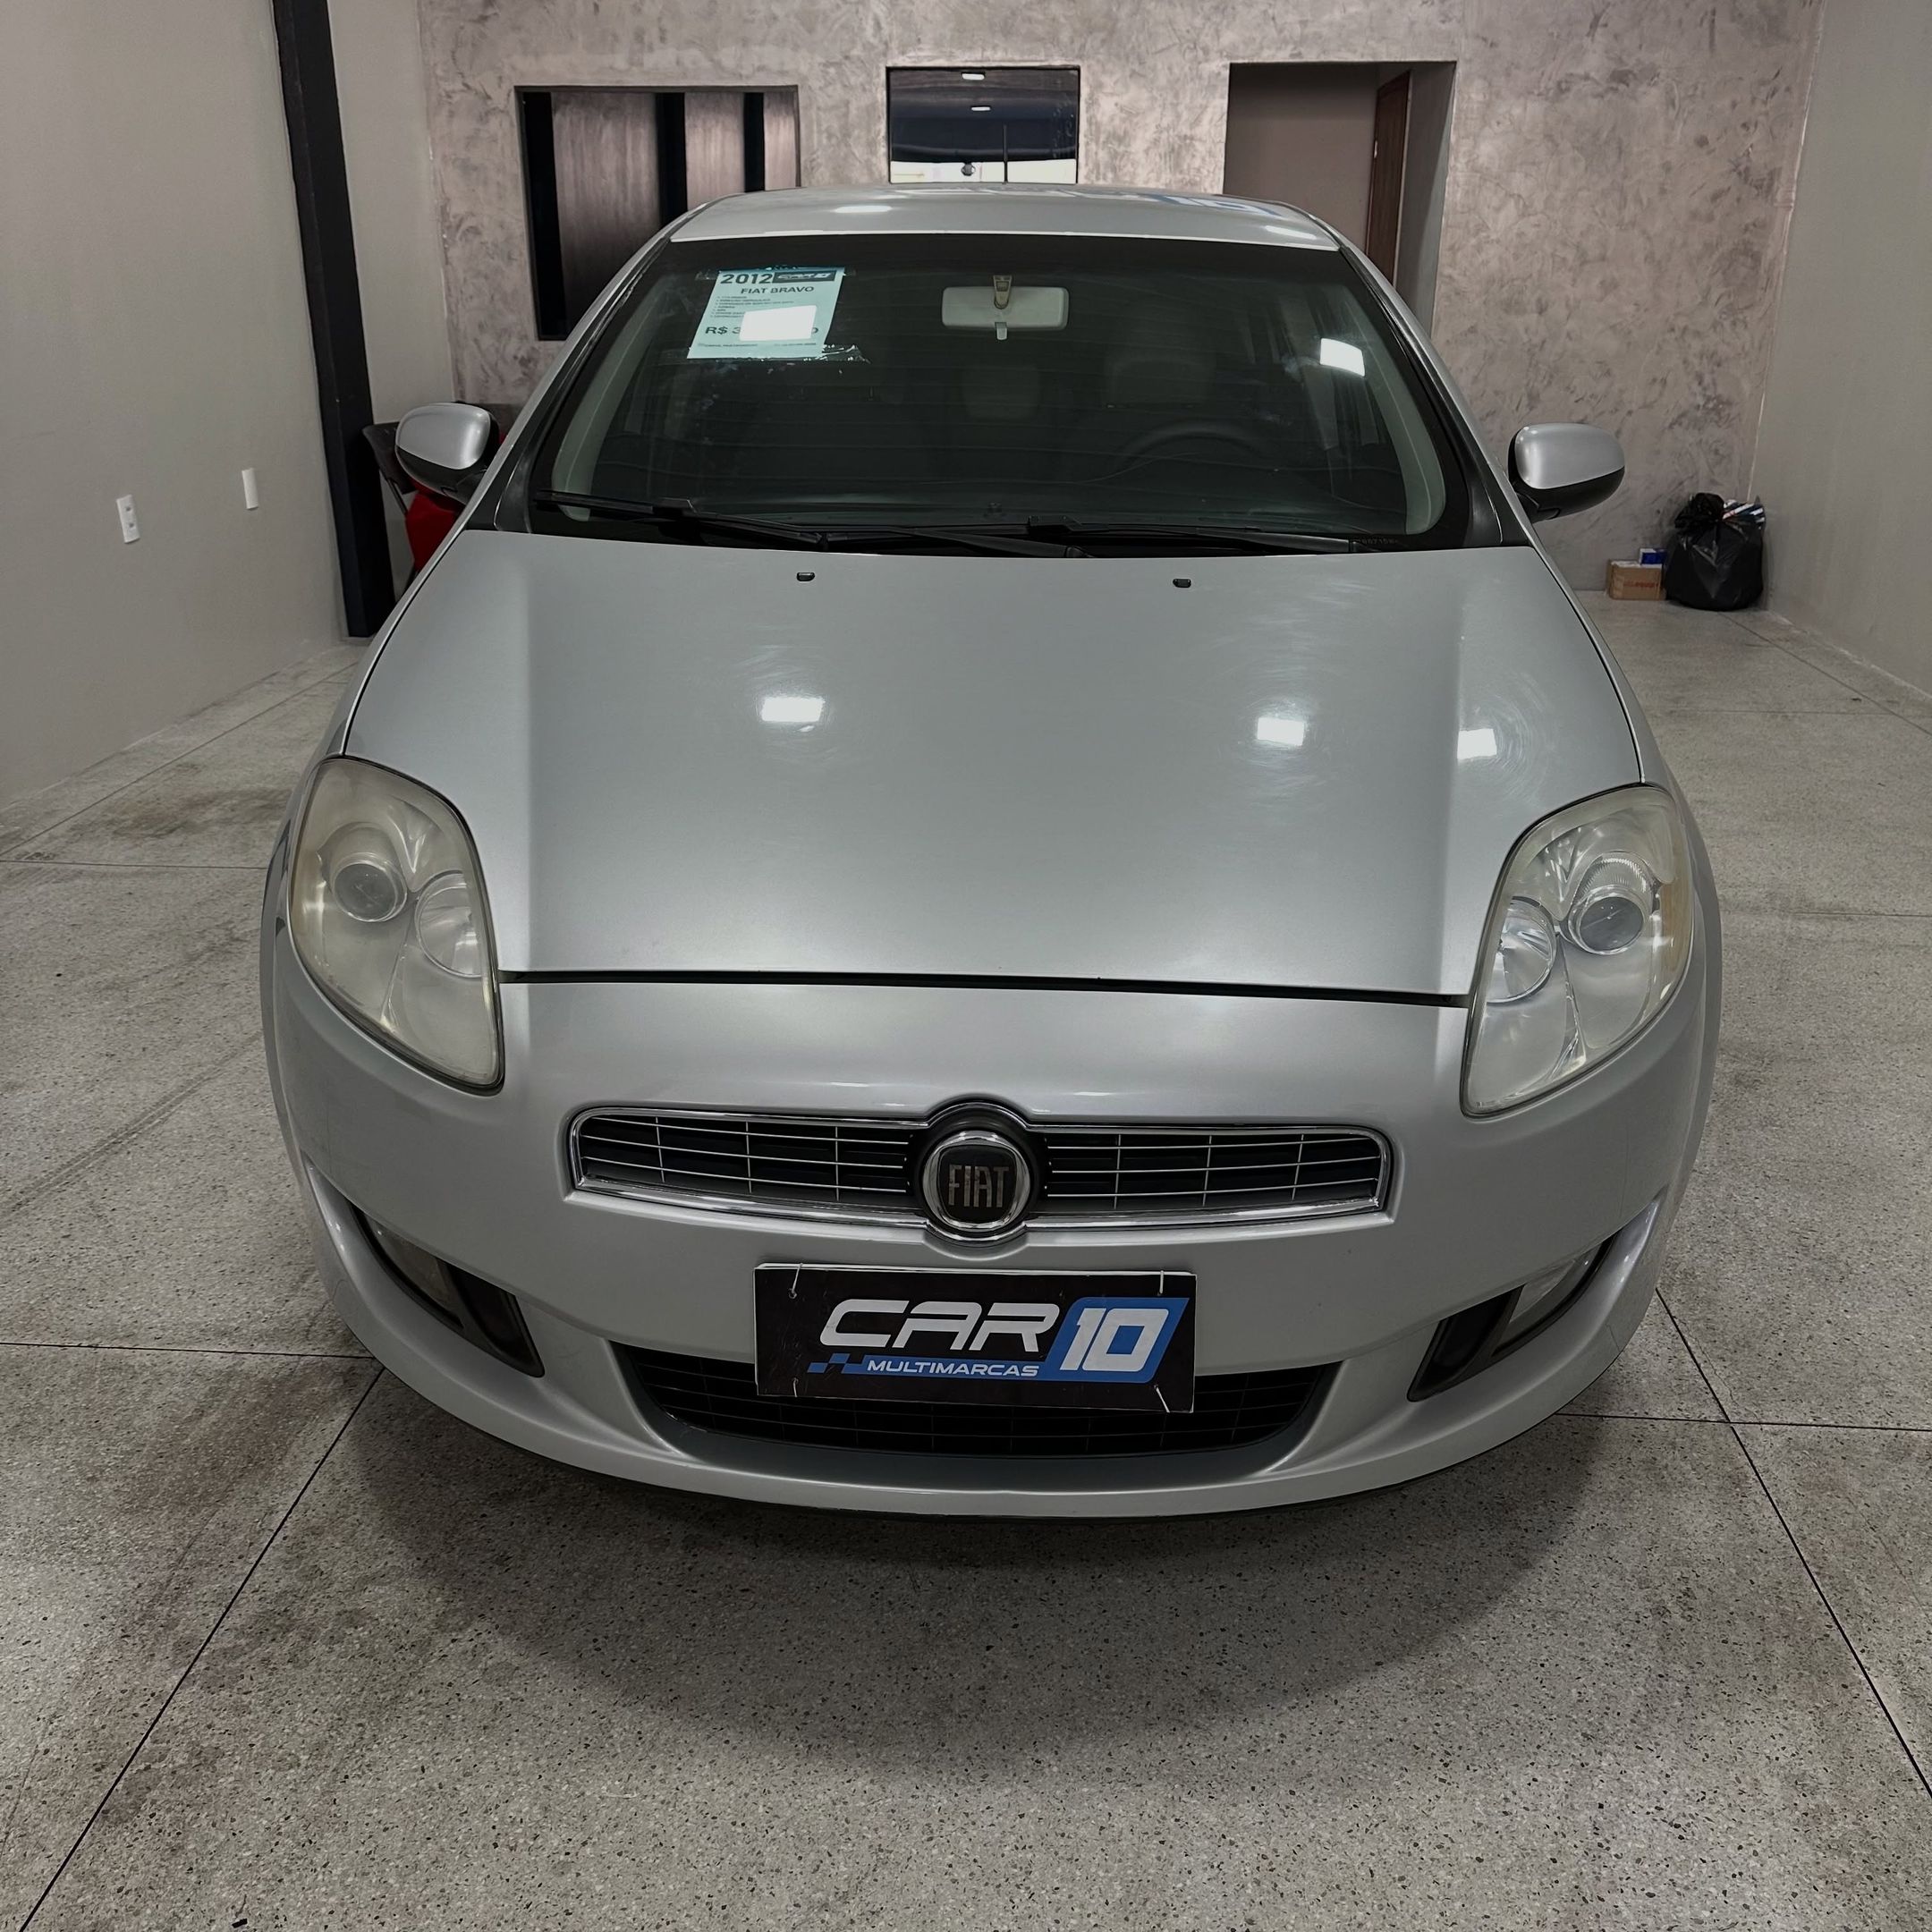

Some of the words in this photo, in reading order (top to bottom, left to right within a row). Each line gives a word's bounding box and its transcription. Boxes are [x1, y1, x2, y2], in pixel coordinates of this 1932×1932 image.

[720, 274, 773, 284] 2012
[705, 326, 728, 335] R$
[948, 1164, 1009, 1208] FIAT
[819, 1299, 1060, 1352] CAR
[1059, 1308, 1169, 1372] 10
[867, 1359, 1039, 1377] MULTIMARCAS
